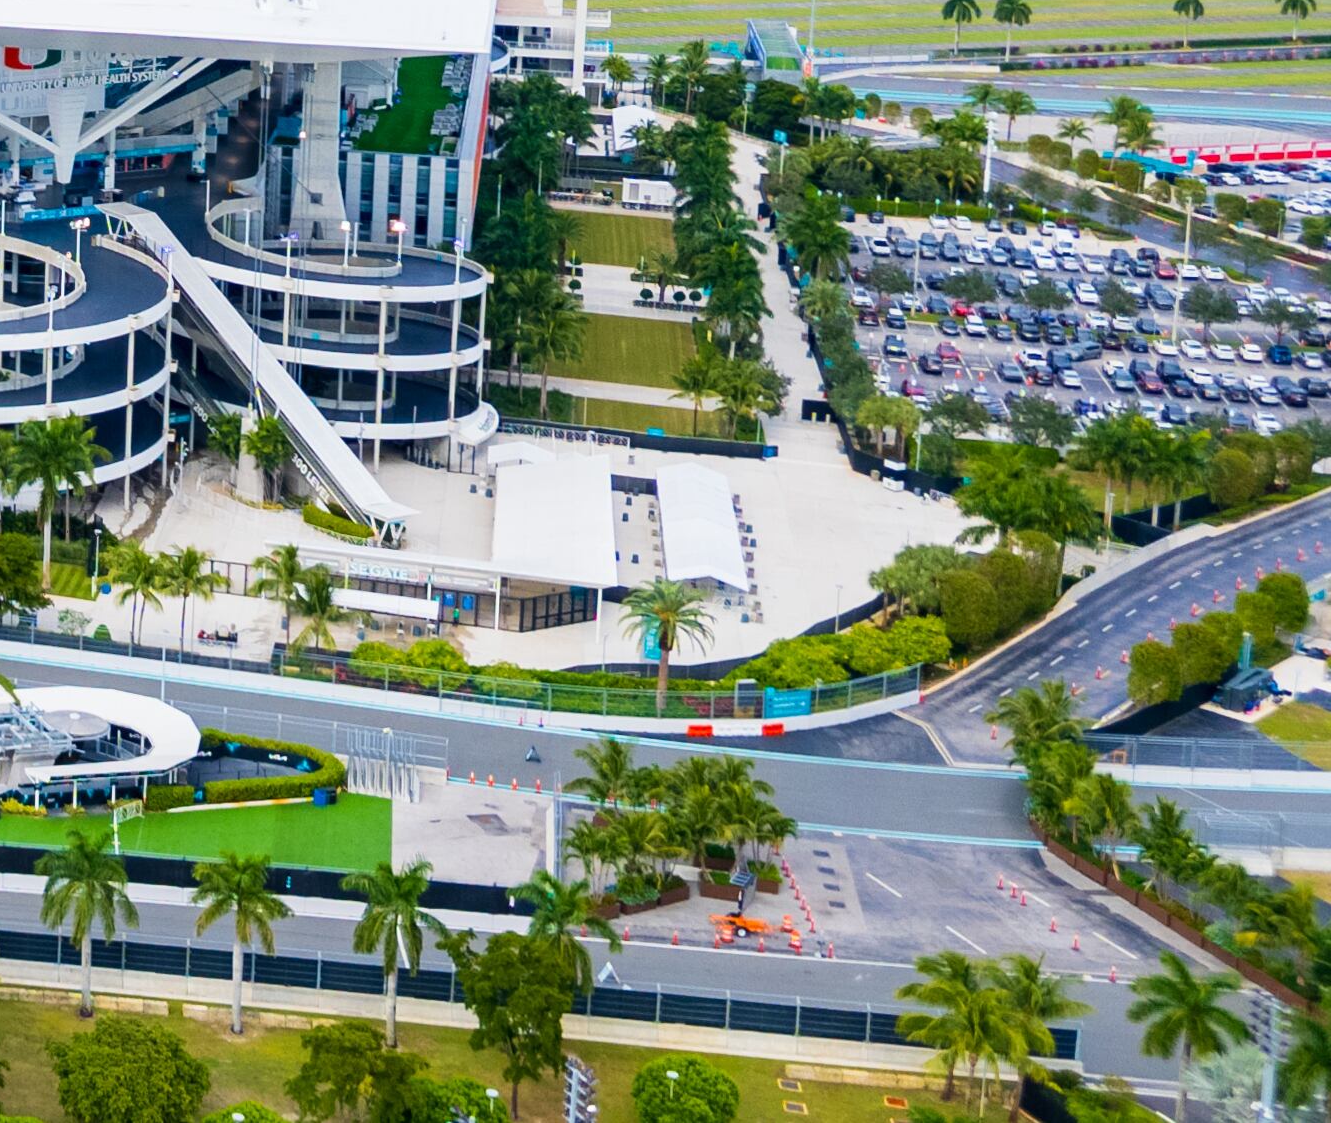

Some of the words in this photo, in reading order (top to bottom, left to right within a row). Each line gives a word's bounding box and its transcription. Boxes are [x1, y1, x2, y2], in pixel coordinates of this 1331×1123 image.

[0, 78, 55, 93] UNIVERSITY
[55, 76, 67, 89] OF
[67, 74, 99, 88] MIAMI
[99, 72, 132, 85] HEALTH
[133, 69, 166, 82] SYSTEM
[193, 403, 209, 423] 200
[291, 451, 309, 475] 300
[306, 469, 332, 503] LEVEL
